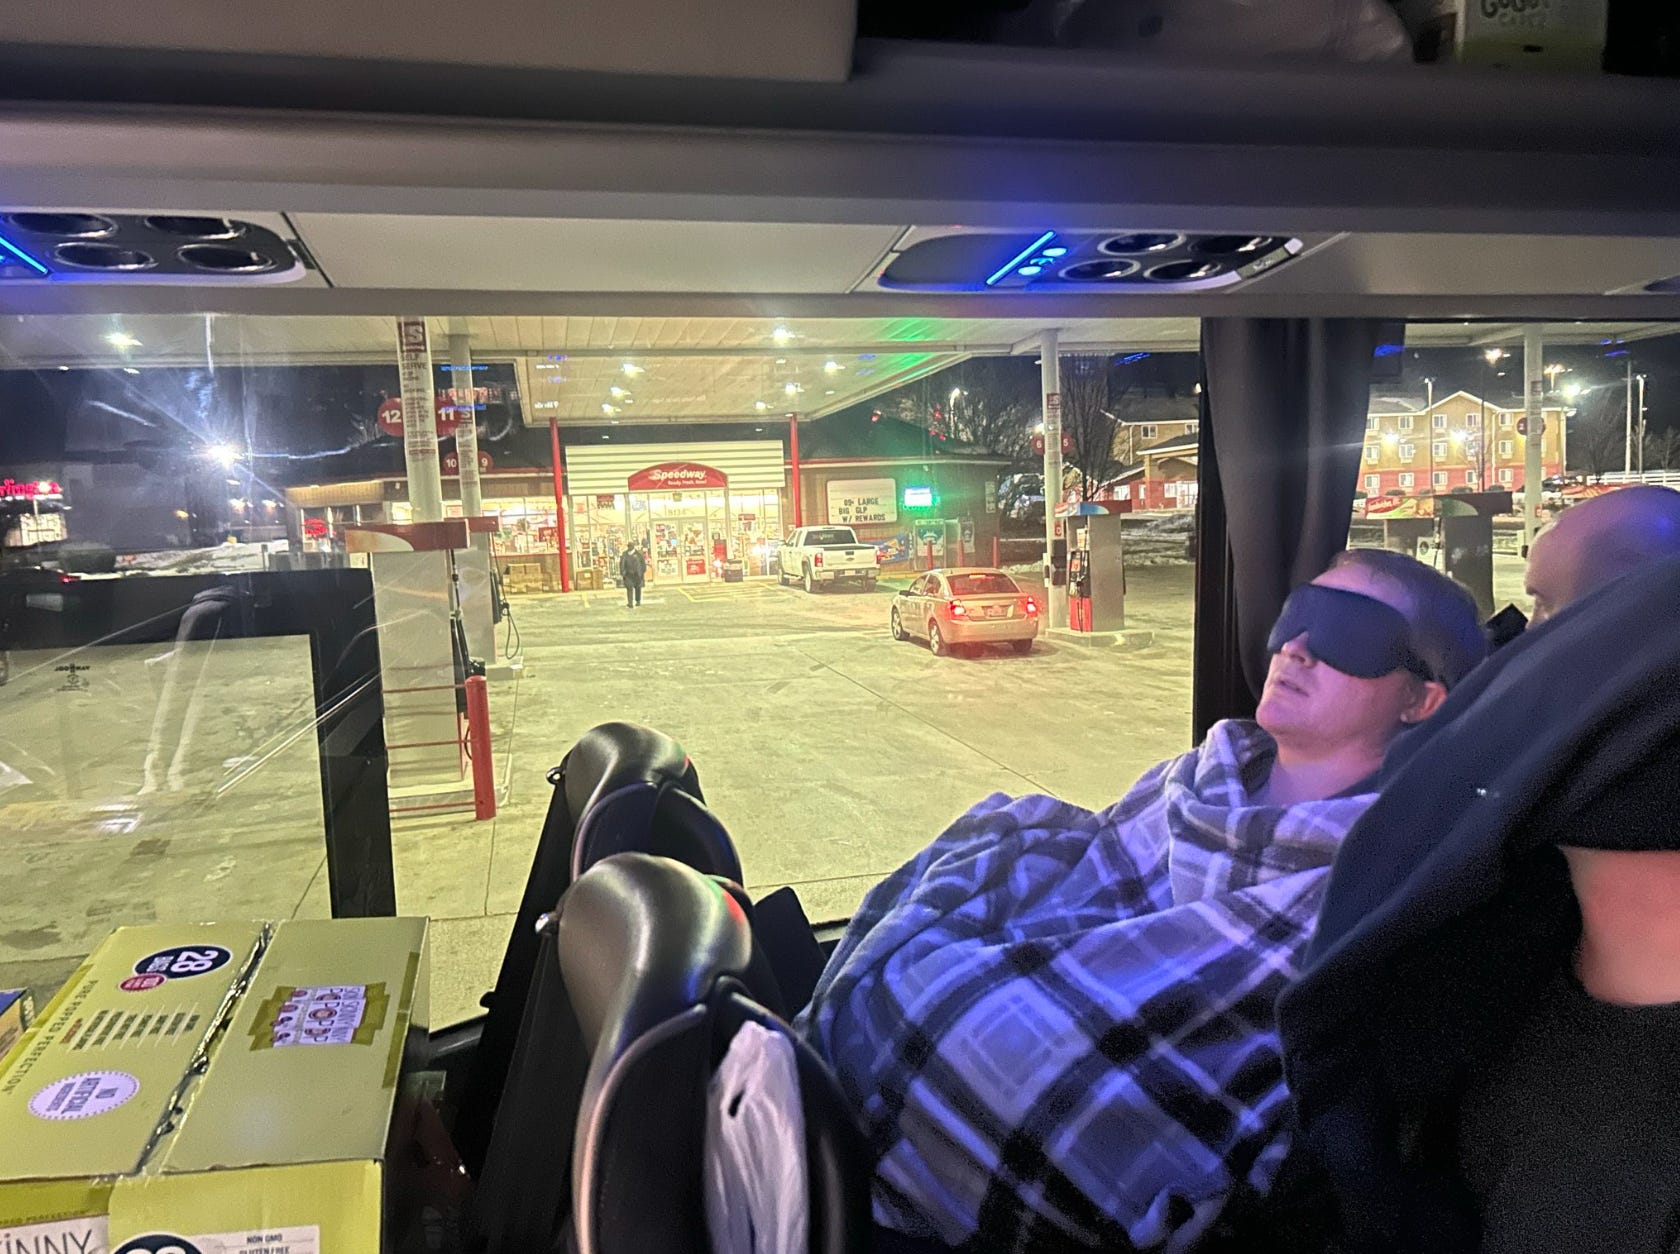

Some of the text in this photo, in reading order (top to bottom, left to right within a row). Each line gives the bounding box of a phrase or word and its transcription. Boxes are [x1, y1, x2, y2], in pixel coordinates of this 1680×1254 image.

[382, 410, 402, 424] 12
[438, 408, 455, 421] 11
[446, 459, 457, 468] 10
[481, 457, 488, 467] 9
[649, 469, 706, 480] Speedway
[857, 498, 879, 506] LARGE
[839, 507, 849, 515] BIG
[855, 514, 886, 522] REWARDS
[170, 950, 219, 973] 28
[75, 979, 99, 1000] PURE
[48, 1001, 80, 1033] POPPED
[2, 1035, 54, 1093] PERFECTION
[247, 1234, 283, 1244] NON GMO
